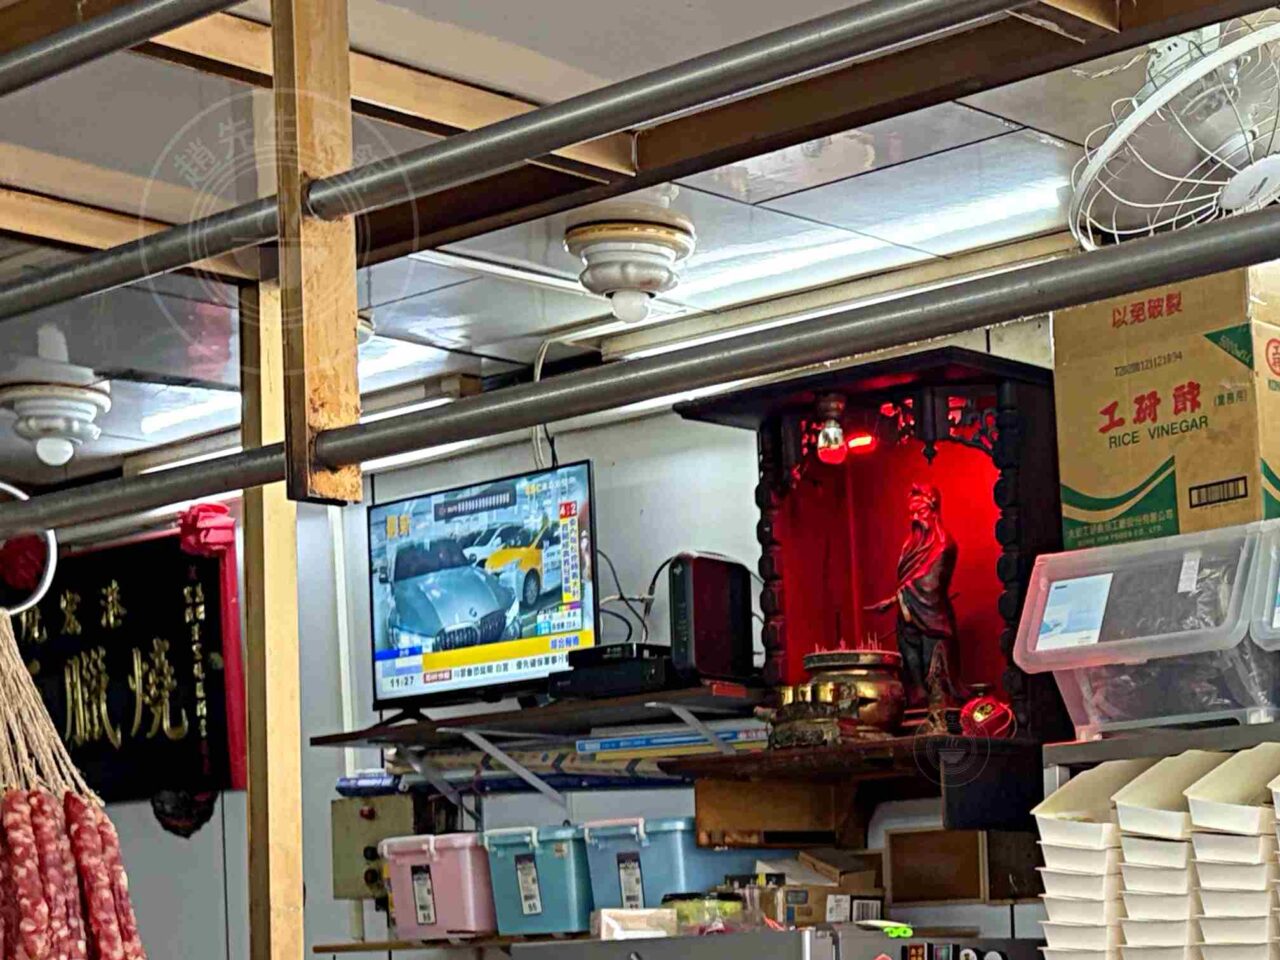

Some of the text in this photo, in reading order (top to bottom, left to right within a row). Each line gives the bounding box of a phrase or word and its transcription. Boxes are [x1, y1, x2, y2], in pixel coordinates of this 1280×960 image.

[1108, 415, 1209, 449] RICE VINEGAR
[389, 676, 415, 688] 11:27
